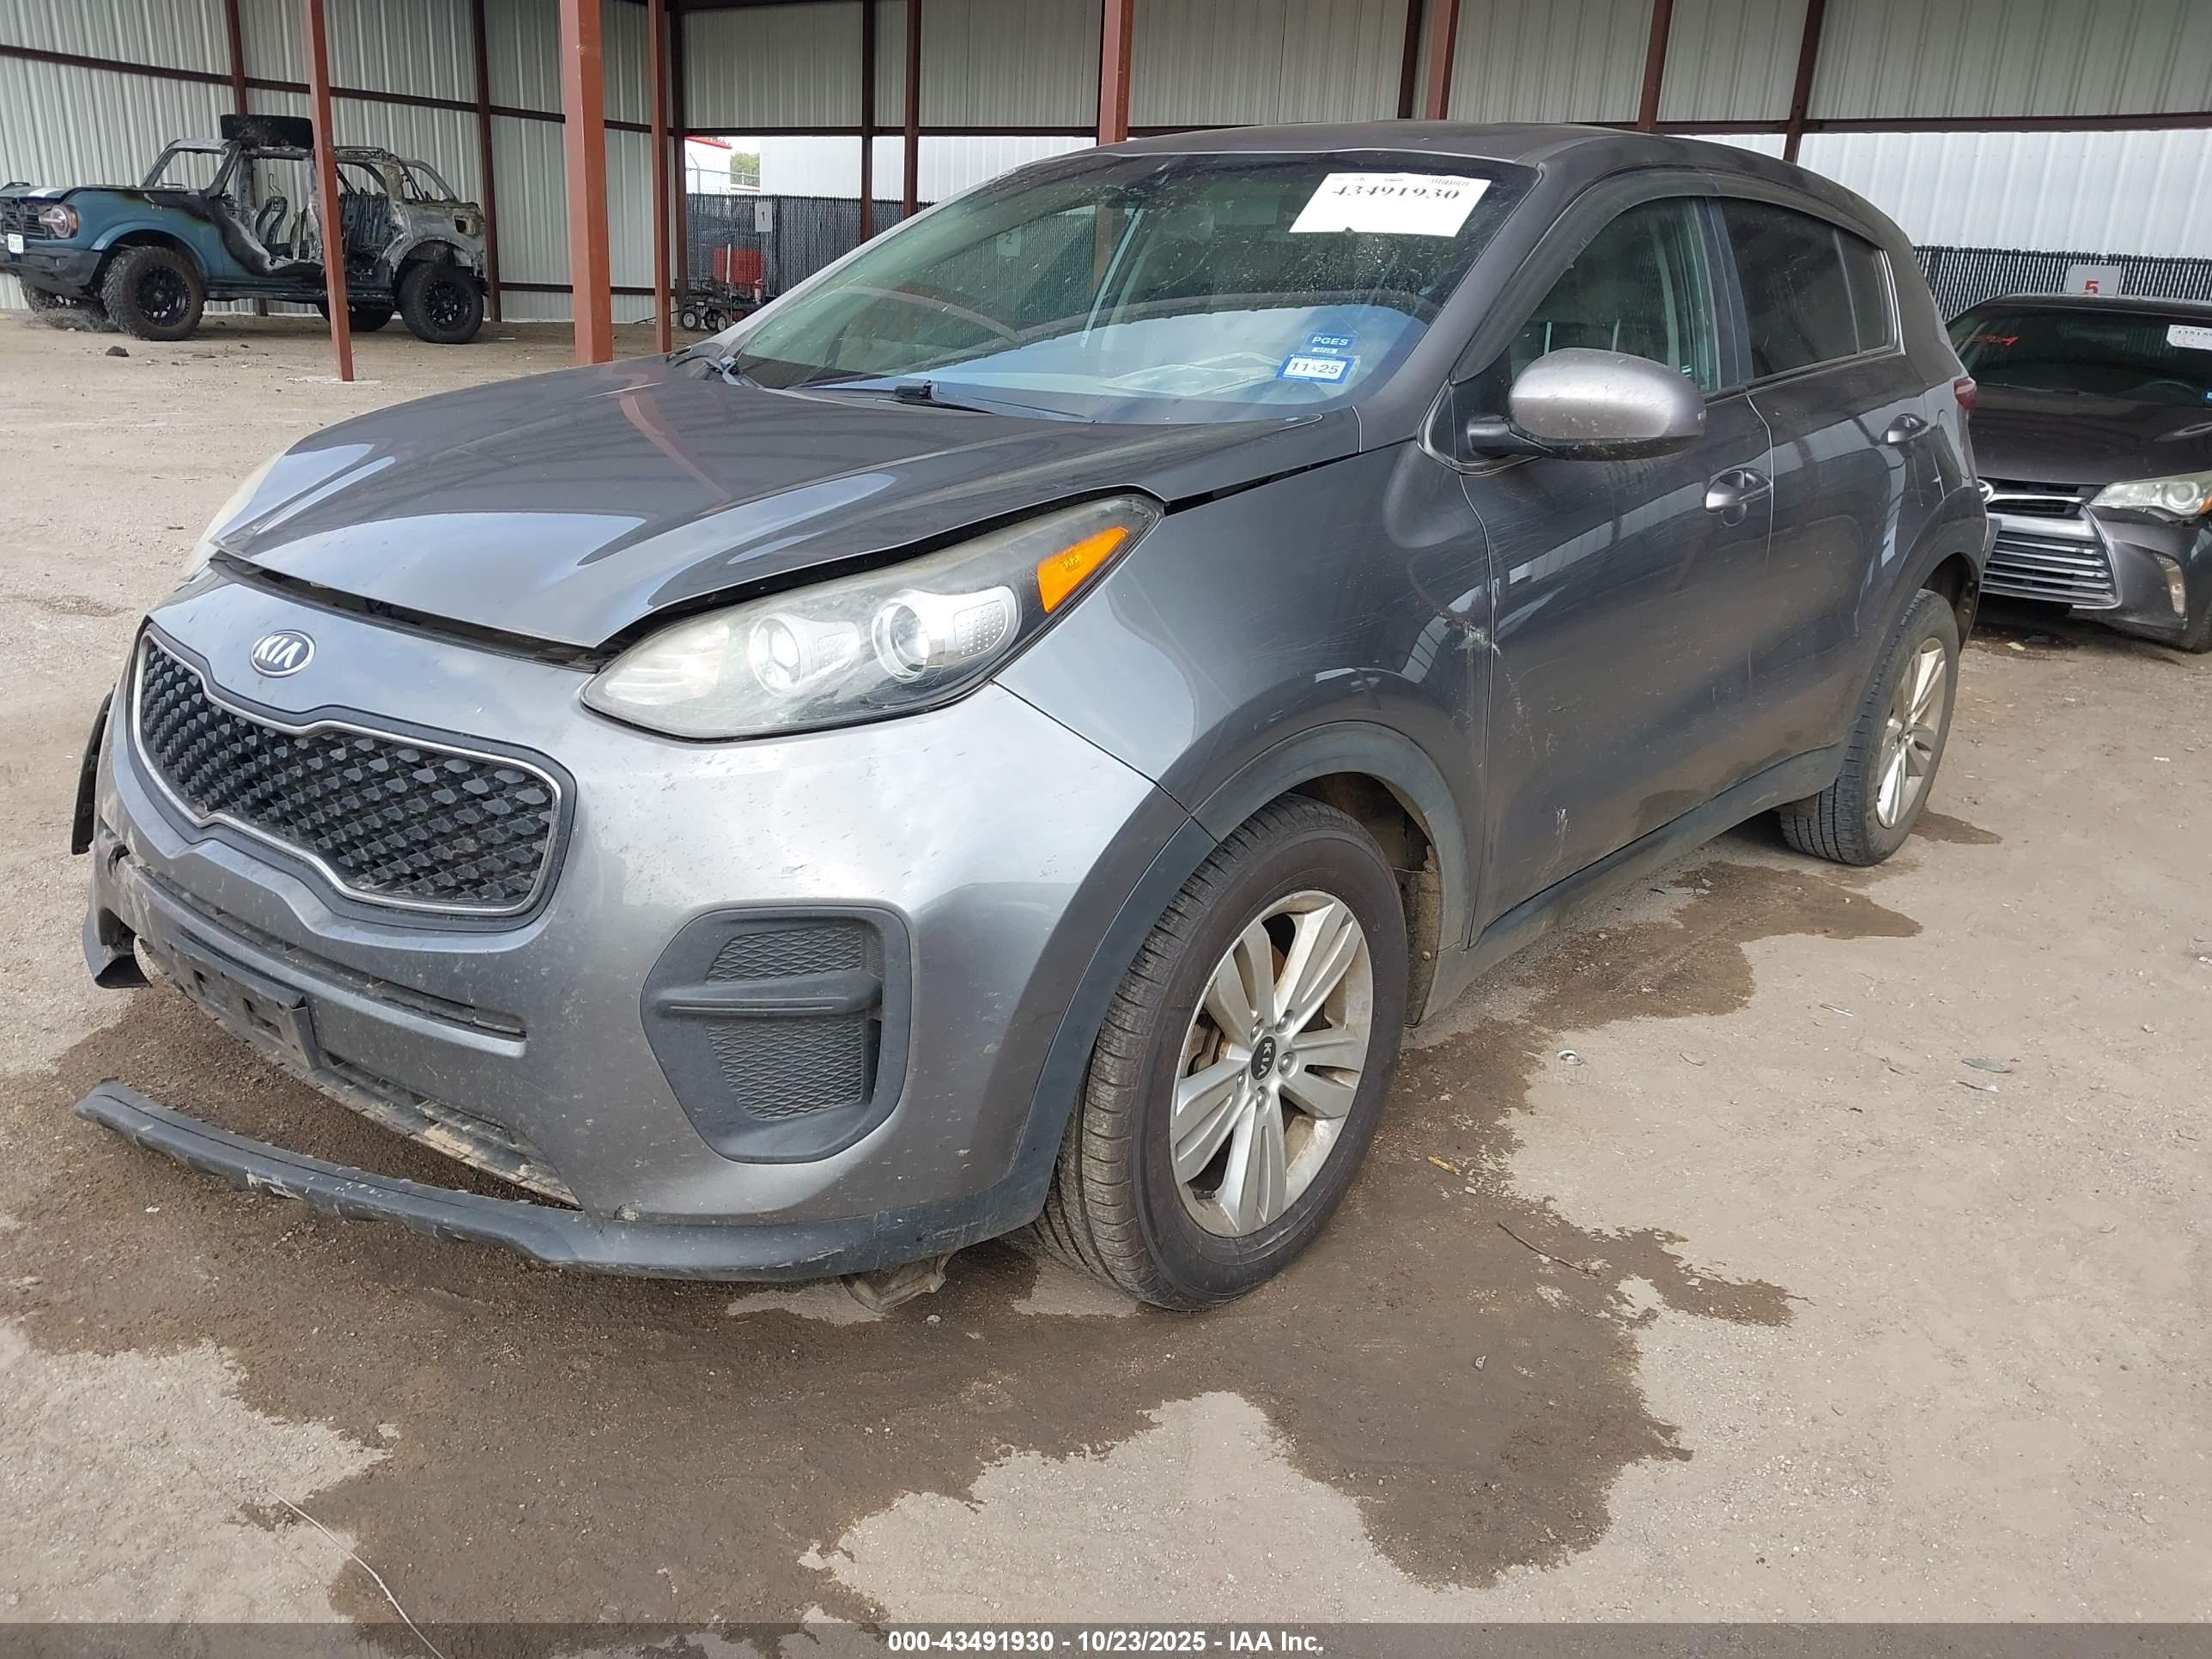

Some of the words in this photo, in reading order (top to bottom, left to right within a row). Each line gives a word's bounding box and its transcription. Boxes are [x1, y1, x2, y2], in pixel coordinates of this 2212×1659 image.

[1333, 185, 1460, 199] 43491930
[2084, 280, 2100, 294] 5
[1311, 337, 1349, 346] PGES
[254, 635, 302, 668] KIA
[1258, 1042, 1273, 1077] KIA
